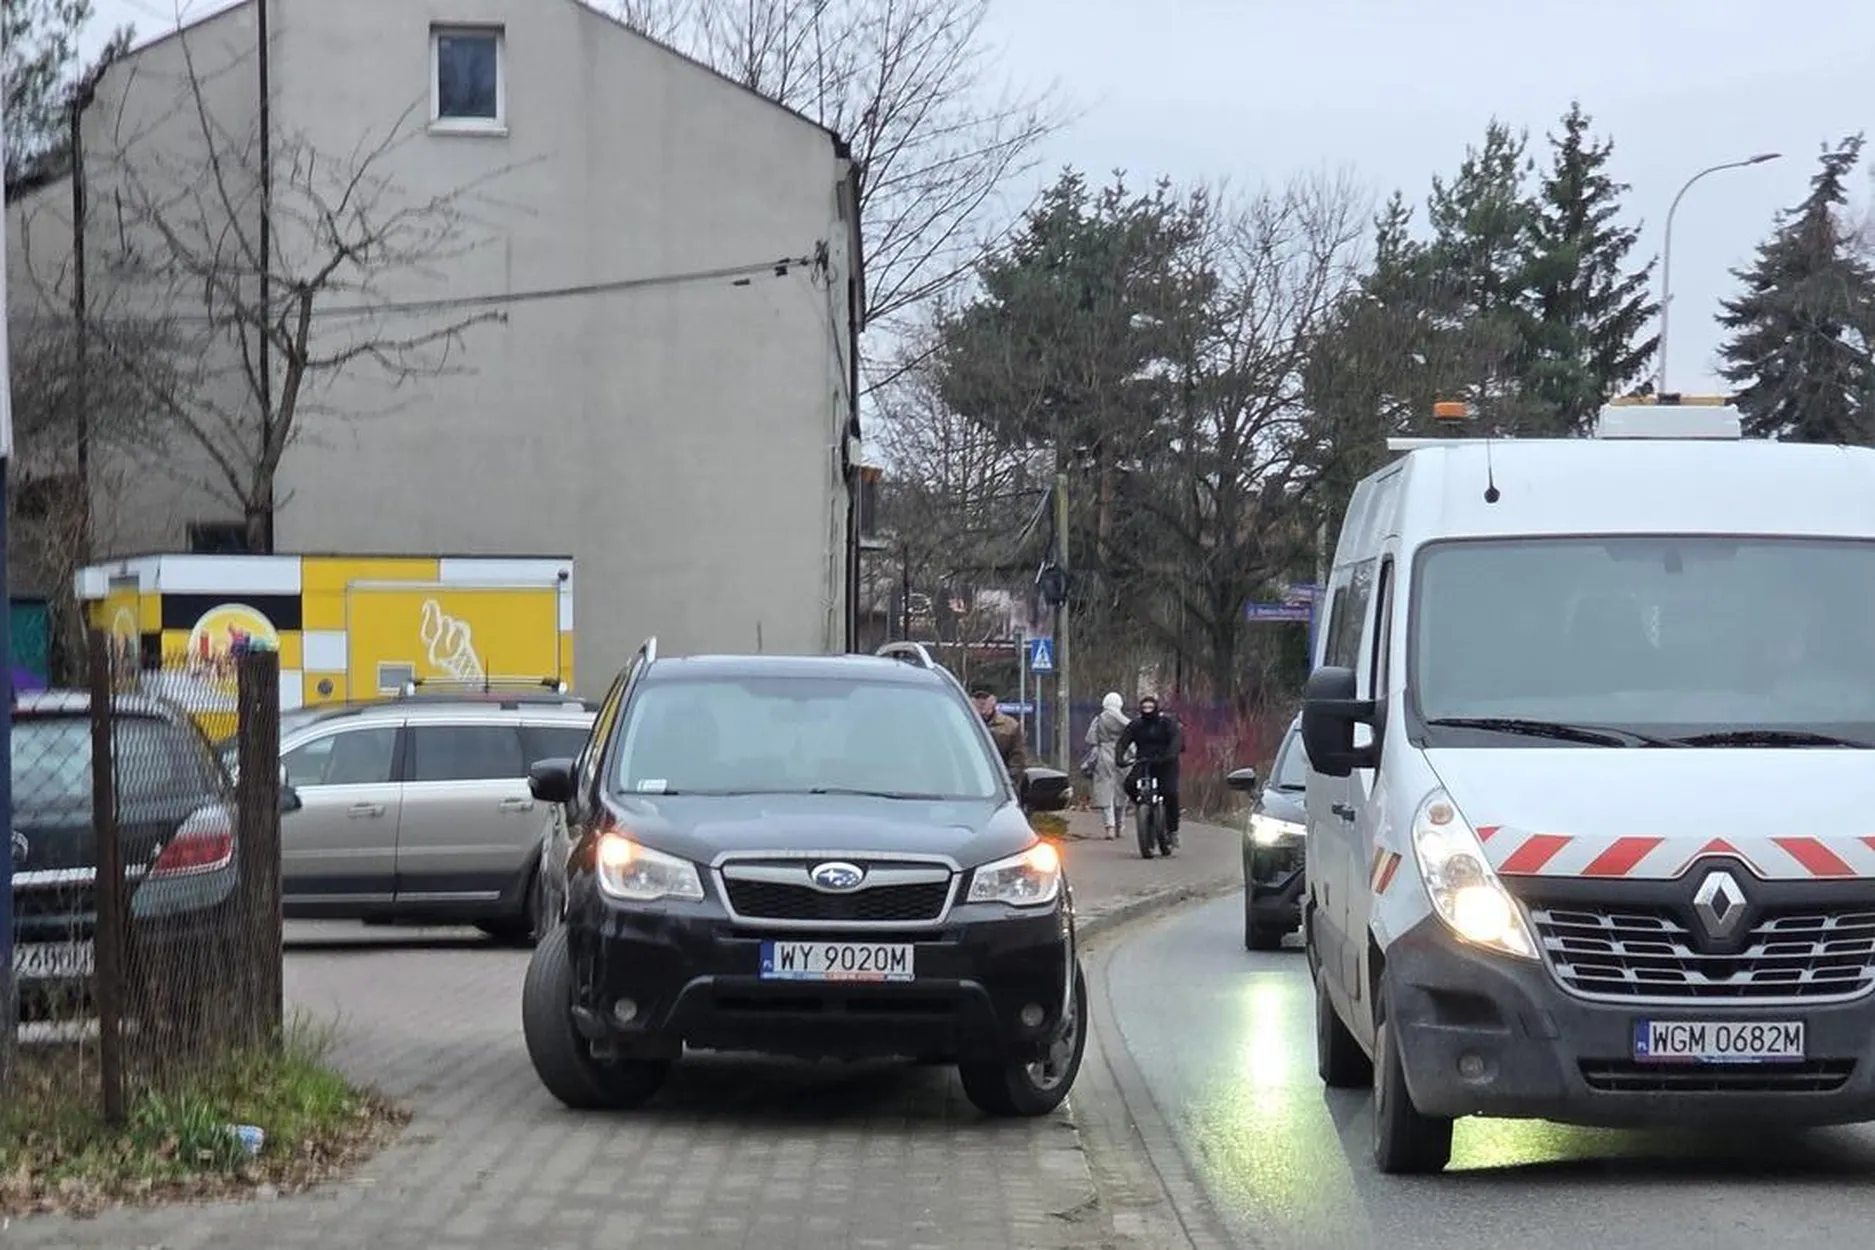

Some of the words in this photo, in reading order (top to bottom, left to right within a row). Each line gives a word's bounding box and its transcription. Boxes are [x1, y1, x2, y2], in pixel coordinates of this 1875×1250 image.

[780, 945, 813, 970] WY
[824, 946, 906, 971] 9020M
[1653, 1025, 1705, 1053] WGM
[1715, 1025, 1800, 1053] 0682M
